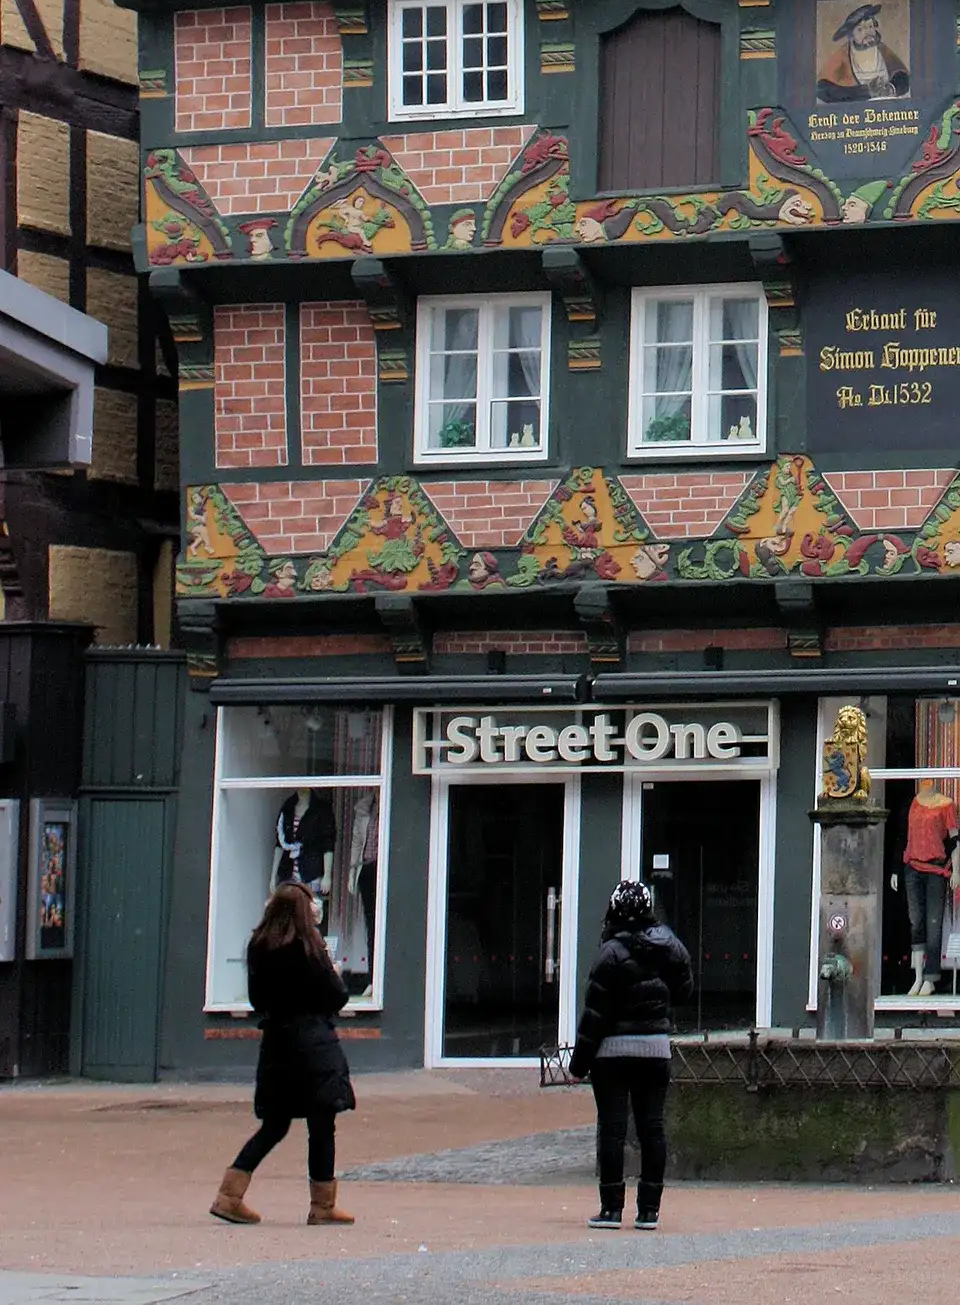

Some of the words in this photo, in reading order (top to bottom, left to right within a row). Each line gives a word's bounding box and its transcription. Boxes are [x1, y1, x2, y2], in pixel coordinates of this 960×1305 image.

[808, 113, 839, 128] Ernst
[842, 113, 860, 125] der
[863, 108, 919, 123] Bekenner
[845, 307, 907, 332] Erbaut
[914, 308, 937, 331] für
[819, 345, 875, 371] Simon
[446, 713, 618, 764] Street
[625, 712, 743, 762] One
